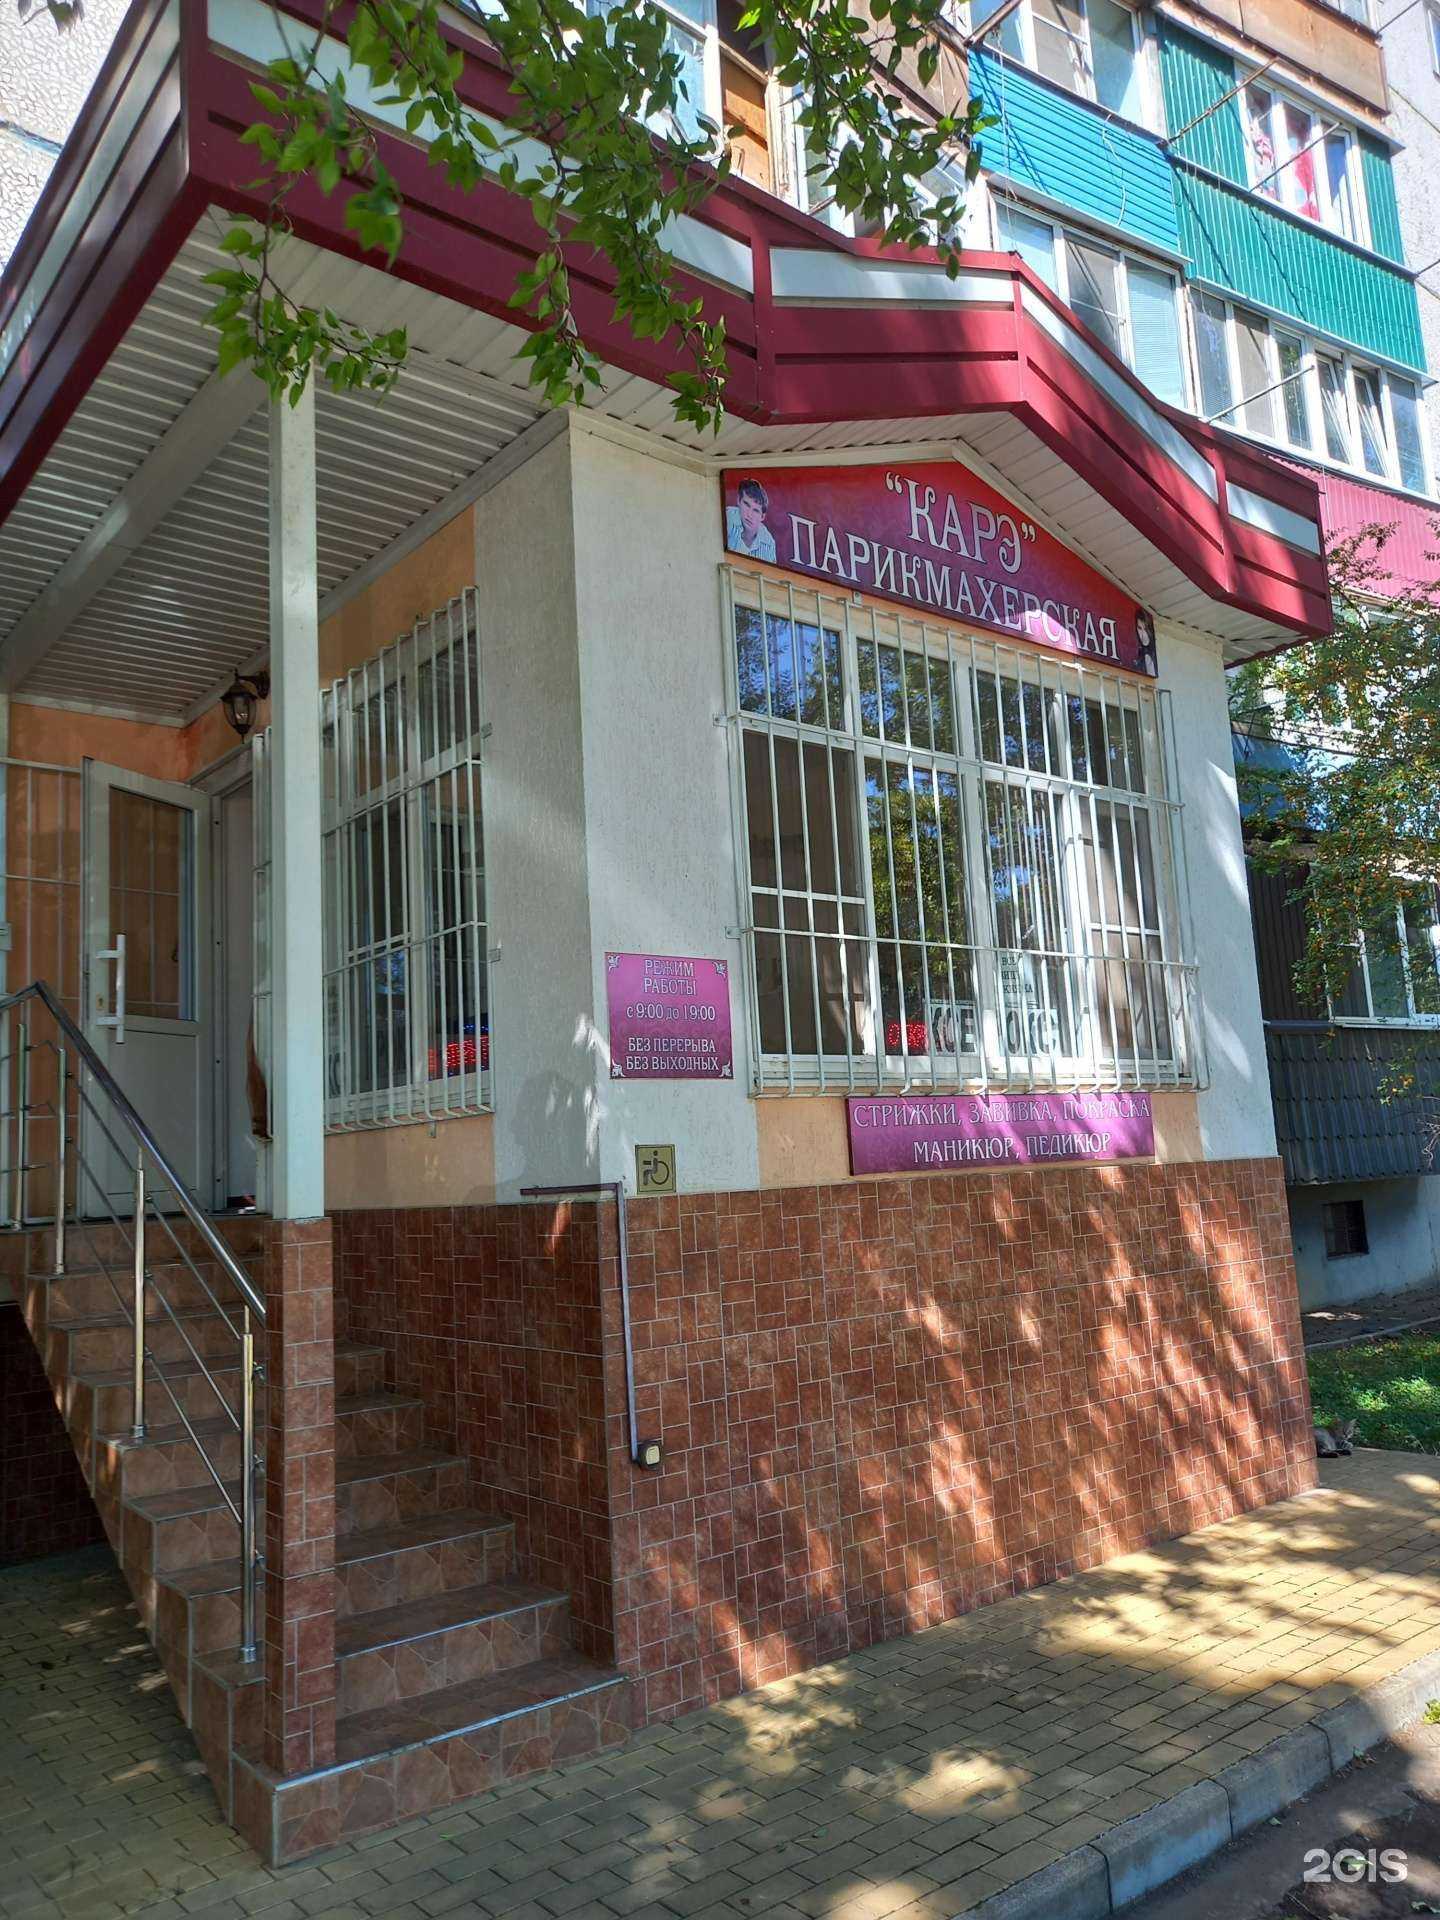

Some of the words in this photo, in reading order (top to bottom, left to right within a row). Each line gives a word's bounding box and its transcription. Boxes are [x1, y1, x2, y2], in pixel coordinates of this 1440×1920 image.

[787, 512, 1121, 661] ПАРИКМАХЕРСКАЯ
[644, 959, 695, 977] РЕЖИМ
[643, 977, 697, 996] РАБОТЫ
[636, 1003, 664, 1019] 9:00
[666, 1007, 680, 1020] до
[683, 1004, 716, 1021] 19:00
[628, 1037, 651, 1052] БЕЗ
[653, 1037, 717, 1053] ПЕРЕРЫВА
[625, 1055, 649, 1070] БЕЗ
[651, 1056, 719, 1072] ВЫХОДНЫХ
[853, 1102, 962, 1128] СТРИЖКИ,
[969, 1101, 1057, 1123] ЗАВИВКА,
[1063, 1098, 1150, 1120] ПОКРАСКА
[913, 1136, 1020, 1163] МАНИКЮР,
[1026, 1132, 1111, 1157] ПЕДИКЮР
